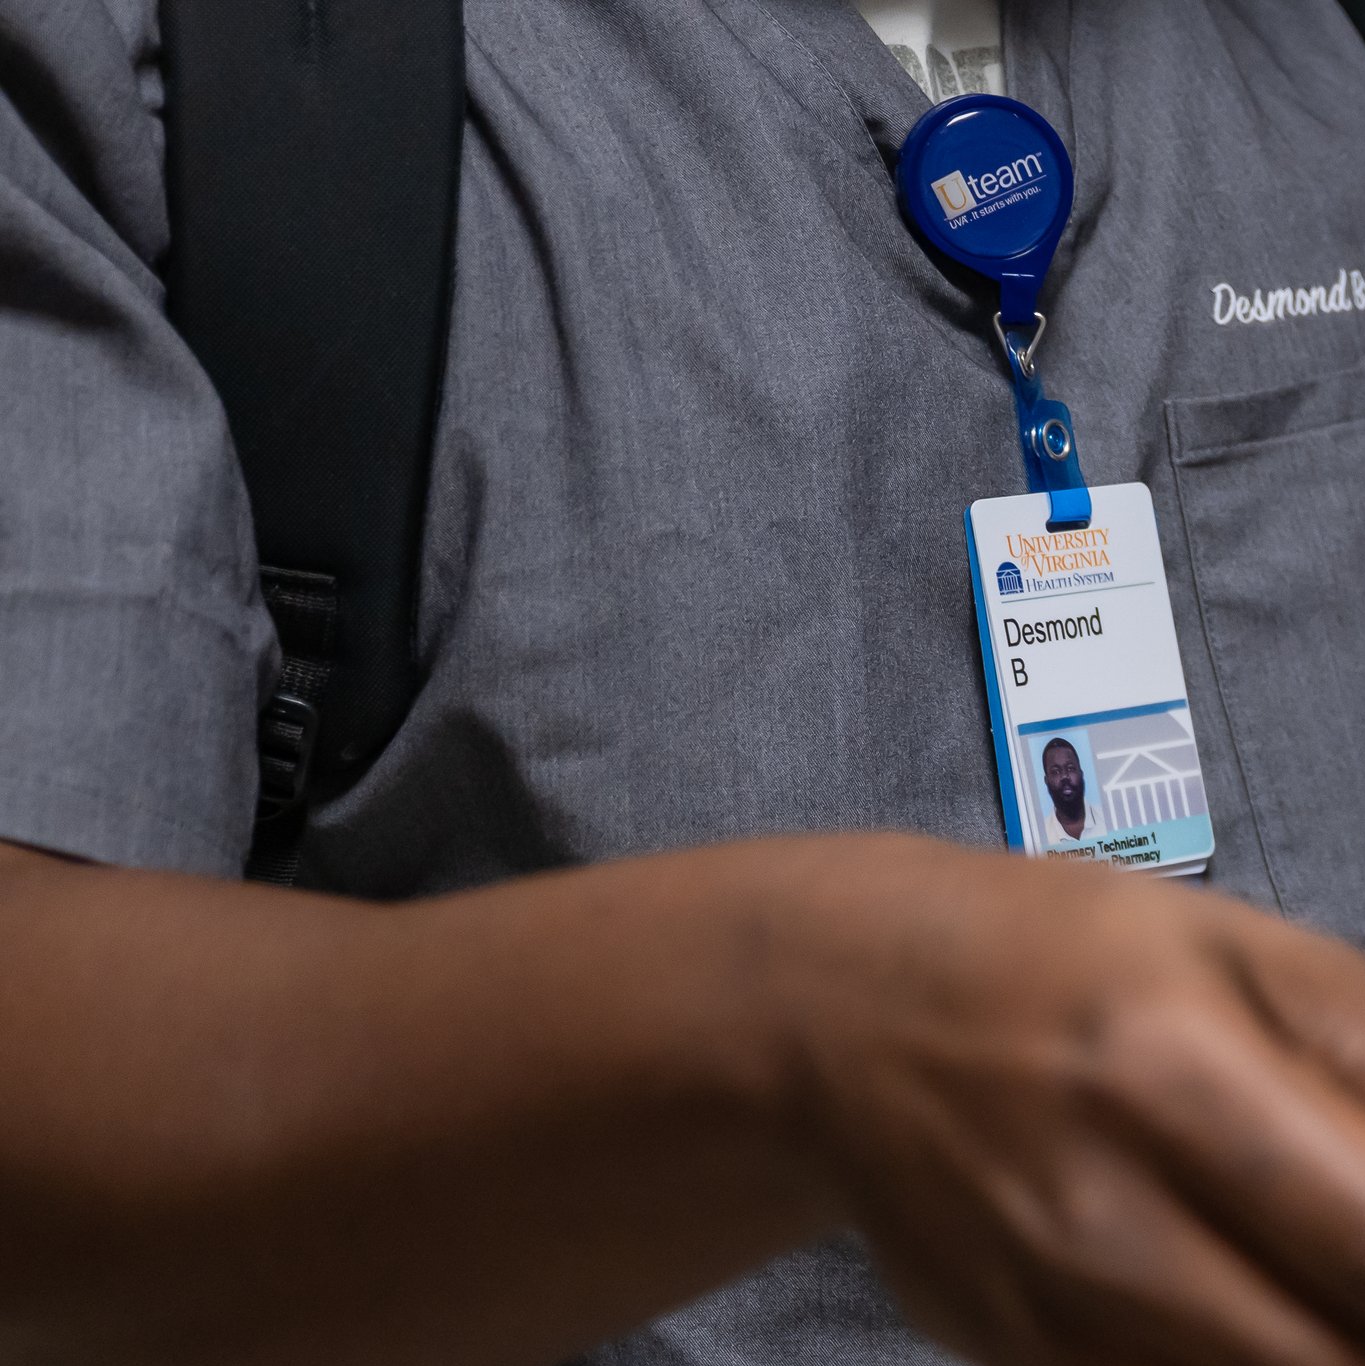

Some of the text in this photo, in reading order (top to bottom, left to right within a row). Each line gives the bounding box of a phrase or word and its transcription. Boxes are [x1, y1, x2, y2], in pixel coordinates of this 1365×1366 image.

[979, 200, 1005, 217] starts
[1005, 192, 1023, 207] with
[1022, 186, 1042, 200] you.
[1210, 267, 1350, 325] Desmond
[1030, 549, 1111, 577] VIRGINIA
[1026, 571, 1115, 592] HEALTH SYSTEM
[1003, 607, 1103, 647] Desmond
[1011, 657, 1029, 687] B
[1097, 834, 1149, 854] Technician
[1151, 832, 1157, 845] 1
[1111, 850, 1161, 867] Pharmacy
